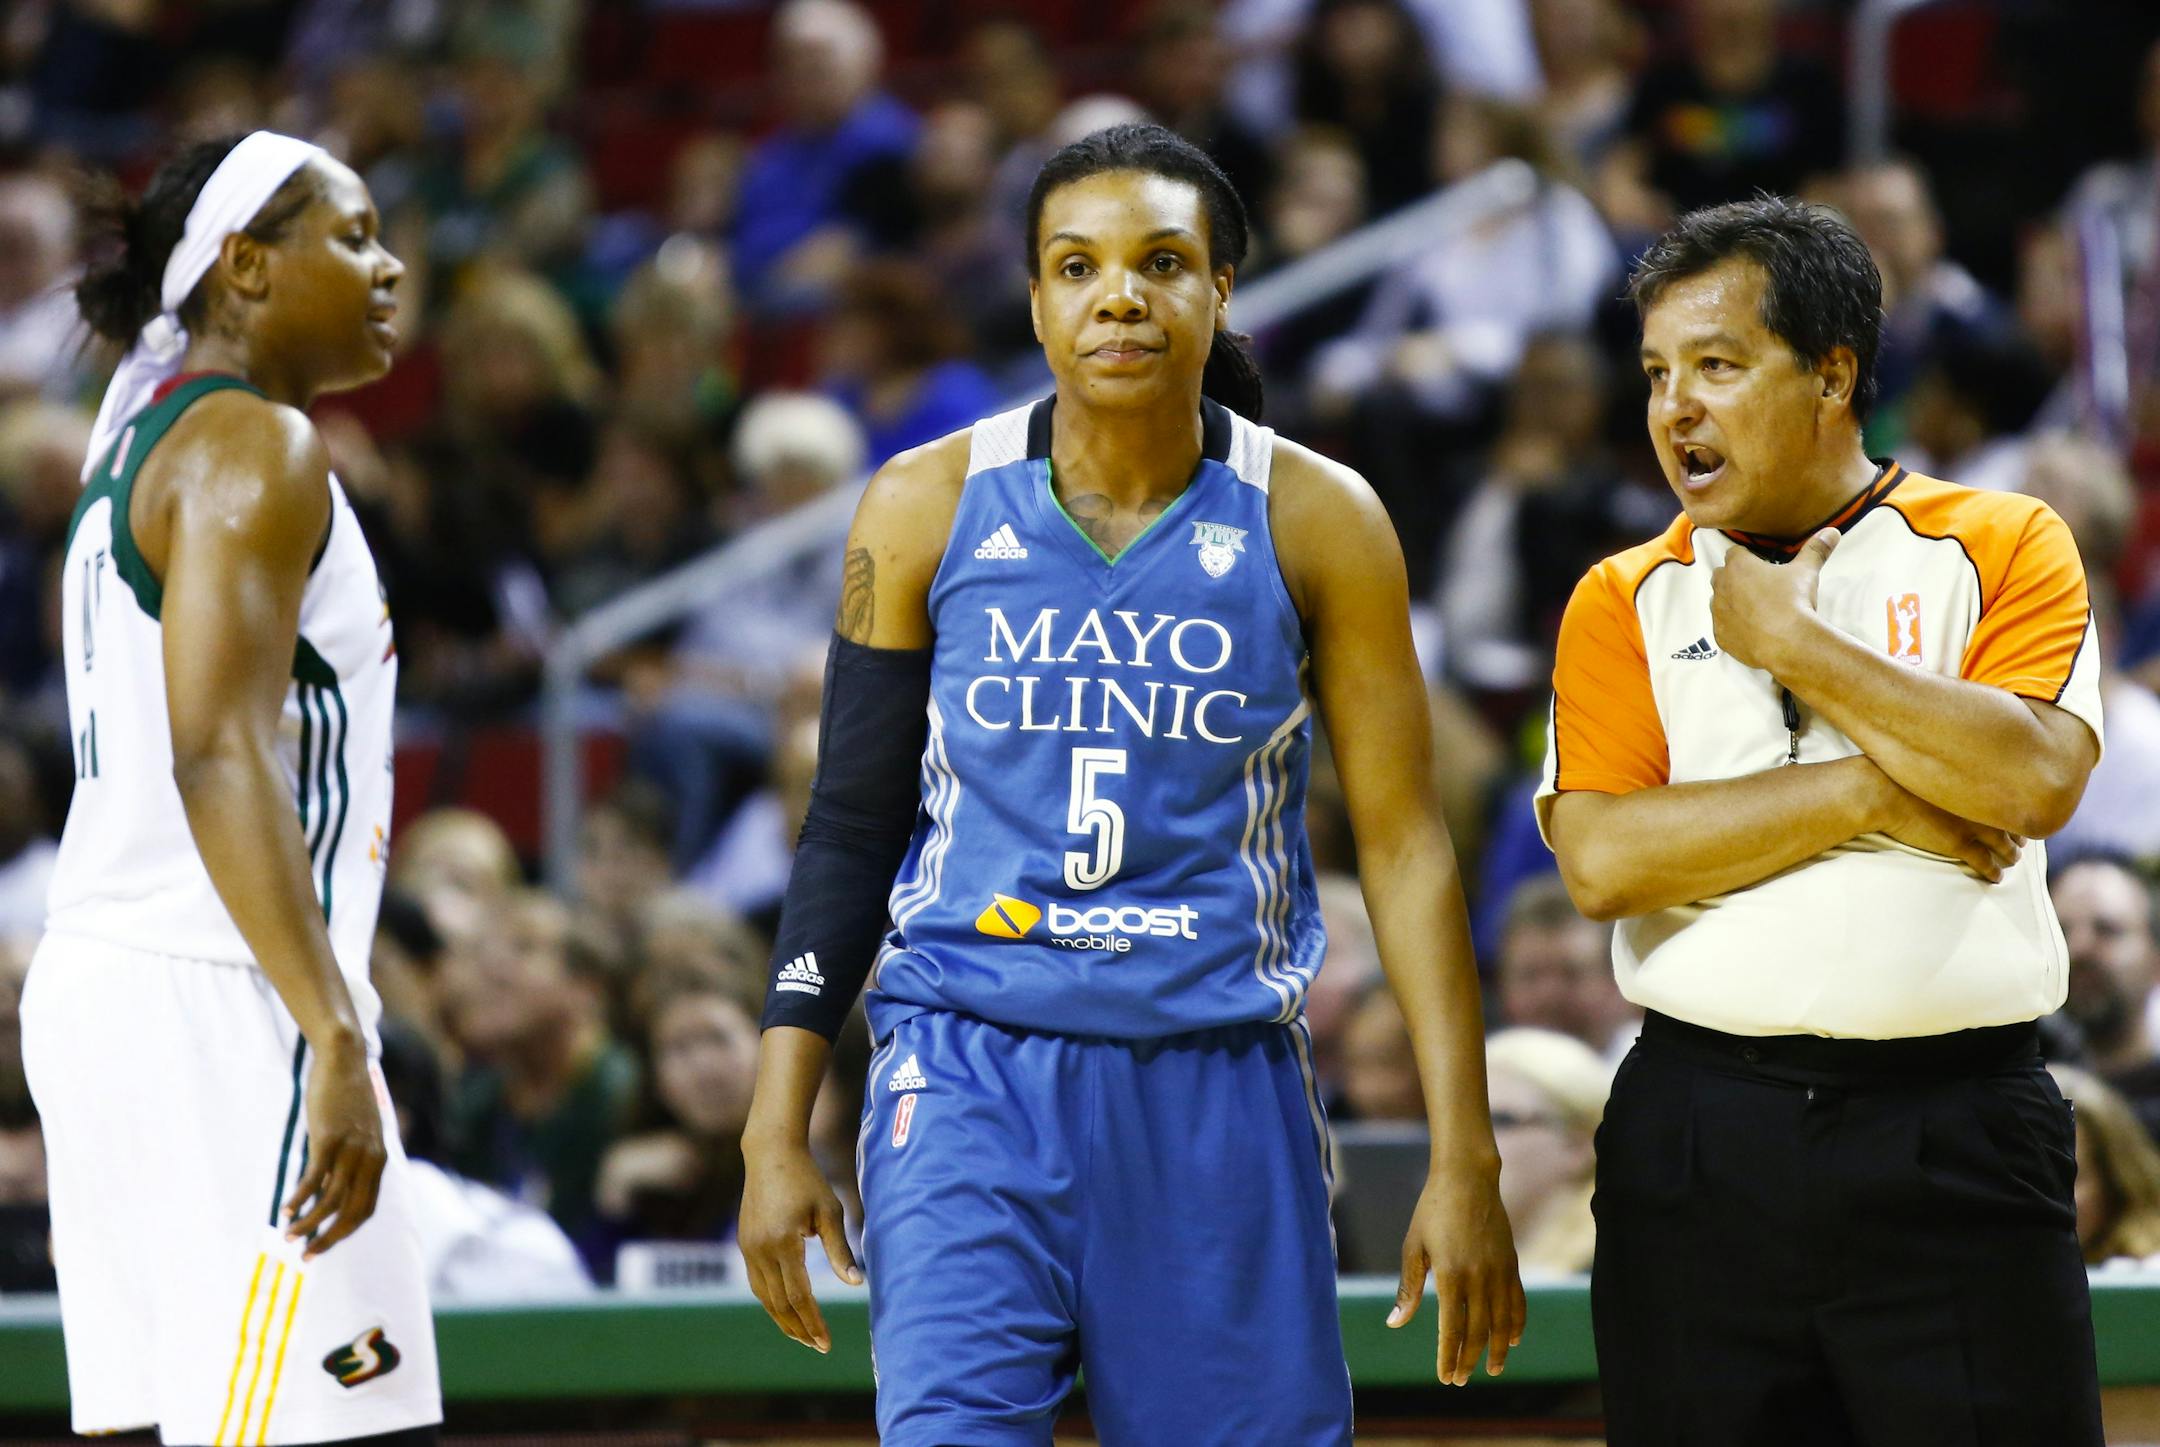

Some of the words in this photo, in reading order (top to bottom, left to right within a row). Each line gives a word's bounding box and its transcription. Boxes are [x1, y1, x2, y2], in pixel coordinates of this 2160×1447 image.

[974, 545, 1028, 560] adidas
[984, 608, 1232, 673] MAYO
[966, 675, 1247, 744] CLINIC
[1064, 747, 1127, 891] 5
[1048, 903, 1199, 940] boost
[1051, 934, 1131, 952] mobile
[778, 969, 825, 985] adidas
[889, 1076, 926, 1091] adidas
